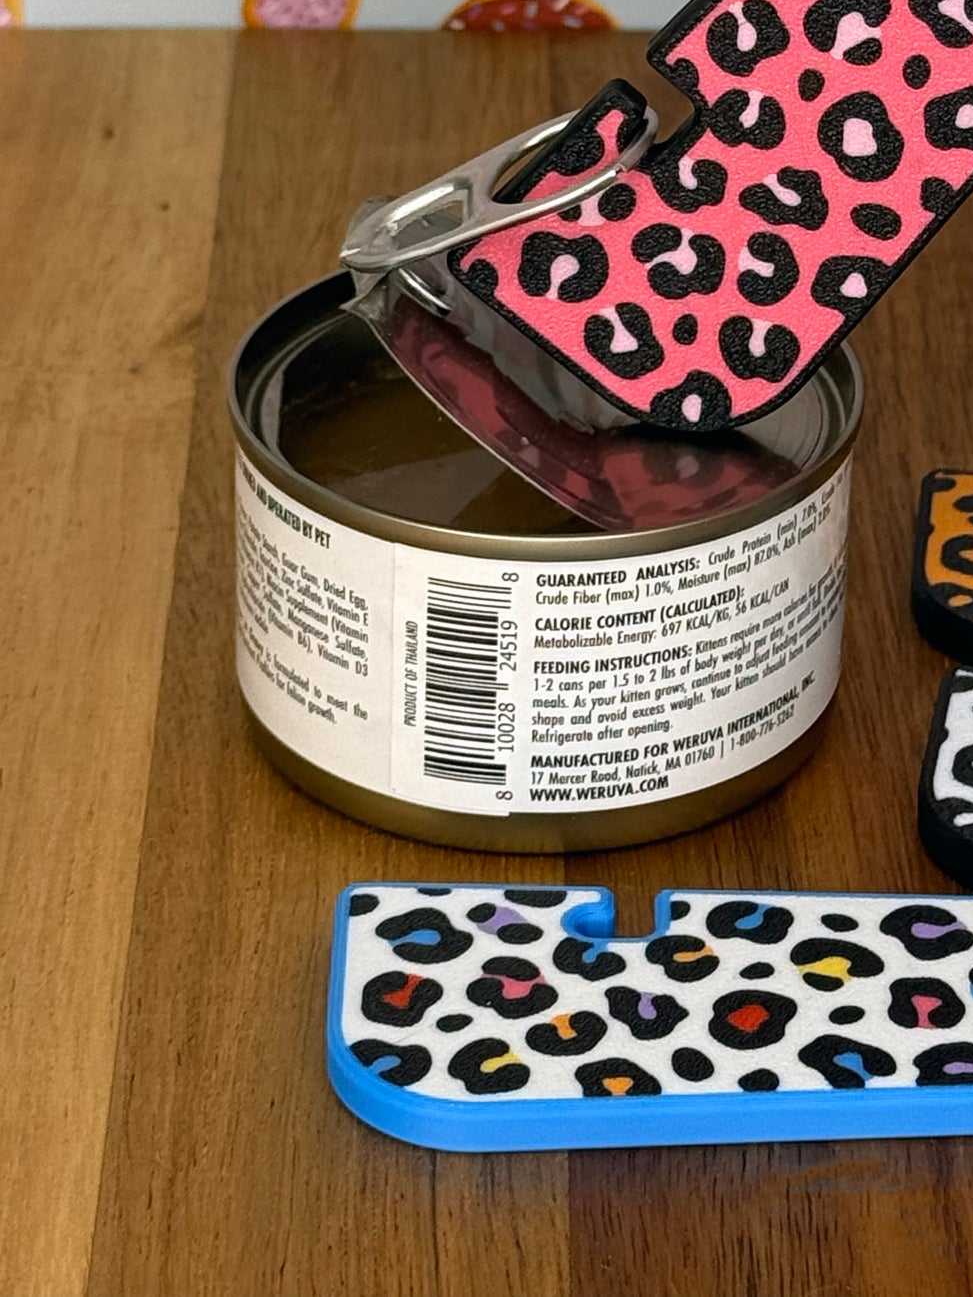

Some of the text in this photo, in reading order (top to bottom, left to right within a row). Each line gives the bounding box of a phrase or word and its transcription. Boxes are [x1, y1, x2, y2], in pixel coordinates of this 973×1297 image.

[267, 494, 301, 533] OPERATED
[302, 519, 314, 540] BY
[314, 527, 332, 549] PET
[535, 570, 627, 588] GUARANTEED
[635, 557, 701, 581] ANALYSIS:
[708, 546, 736, 566] Crude
[742, 532, 772, 555] Protein
[777, 513, 798, 541] (min)
[535, 590, 568, 606] Crude
[573, 589, 602, 606] Fiber
[605, 584, 640, 606] (max)
[645, 579, 675, 598] 1.0%,
[678, 569, 720, 591] Moisture
[723, 558, 751, 582] (max)
[782, 532, 796, 552] Ash
[798, 515, 816, 545] (max)
[323, 578, 346, 601] Dried
[349, 590, 369, 612] Egg,
[327, 596, 360, 623] Vitamin
[363, 613, 369, 627] E
[533, 632, 613, 649] Metabolizable
[661, 620, 683, 637] 697
[685, 607, 732, 632] KCAL/KG,
[735, 601, 747, 617] 56
[749, 577, 790, 610] KCAL/CAN
[534, 584, 746, 632] CALORIE CONTENT (CALCULATED):
[317, 644, 350, 670] Vitamin
[355, 661, 368, 678] D3
[331, 615, 369, 645] (Vitamin
[335, 634, 369, 663] Sulfate,
[533, 660, 591, 675] FEEDING
[594, 644, 692, 673] INSTRUCTIONS:
[695, 636, 728, 655] Kittens
[730, 622, 760, 647] require
[762, 610, 782, 629] more
[783, 592, 808, 617] calories
[533, 677, 553, 692] 1-2
[558, 679, 584, 692] cans
[588, 678, 607, 693] per
[634, 672, 645, 685] to
[649, 668, 657, 683] 2
[661, 665, 676, 680] lbs
[680, 659, 691, 676] of
[694, 653, 719, 672] body
[722, 642, 752, 663] weight
[754, 636, 767, 655] per
[787, 617, 796, 631] or
[274, 653, 309, 693] formulated
[313, 685, 323, 700] to
[327, 694, 349, 713] meet
[353, 703, 368, 721] the
[403, 620, 419, 727] PRODUCT OF THAILAND
[495, 572, 520, 801] 8 10028 24519 8
[531, 710, 565, 729] shape
[570, 709, 592, 725] and
[597, 706, 628, 725] avoid
[632, 703, 665, 719] excess
[670, 692, 706, 712] weight.
[711, 683, 732, 701] Your
[735, 671, 760, 692] kitten
[762, 655, 787, 679] should
[532, 694, 569, 709] meals.
[573, 694, 587, 709] As
[591, 695, 617, 711] your
[620, 689, 651, 704] kitten
[654, 681, 688, 701] grows,
[691, 669, 732, 690] continue
[734, 663, 744, 676] to
[745, 649, 770, 669] adjust
[772, 632, 798, 658] feeding
[530, 749, 639, 768] MANUFACTURED
[643, 741, 669, 760] FOR
[673, 725, 724, 753] WERUVA
[727, 685, 800, 736] INTERNATIONAL,
[531, 718, 674, 746] Refrigerate after opening.
[528, 775, 670, 802] WWW.WERUVA.COM
[531, 771, 545, 785] 17
[548, 772, 587, 785] Mercer
[590, 766, 622, 782] Road,
[625, 759, 661, 780] Natick,
[664, 755, 682, 772] MA
[685, 745, 715, 766] 01760
